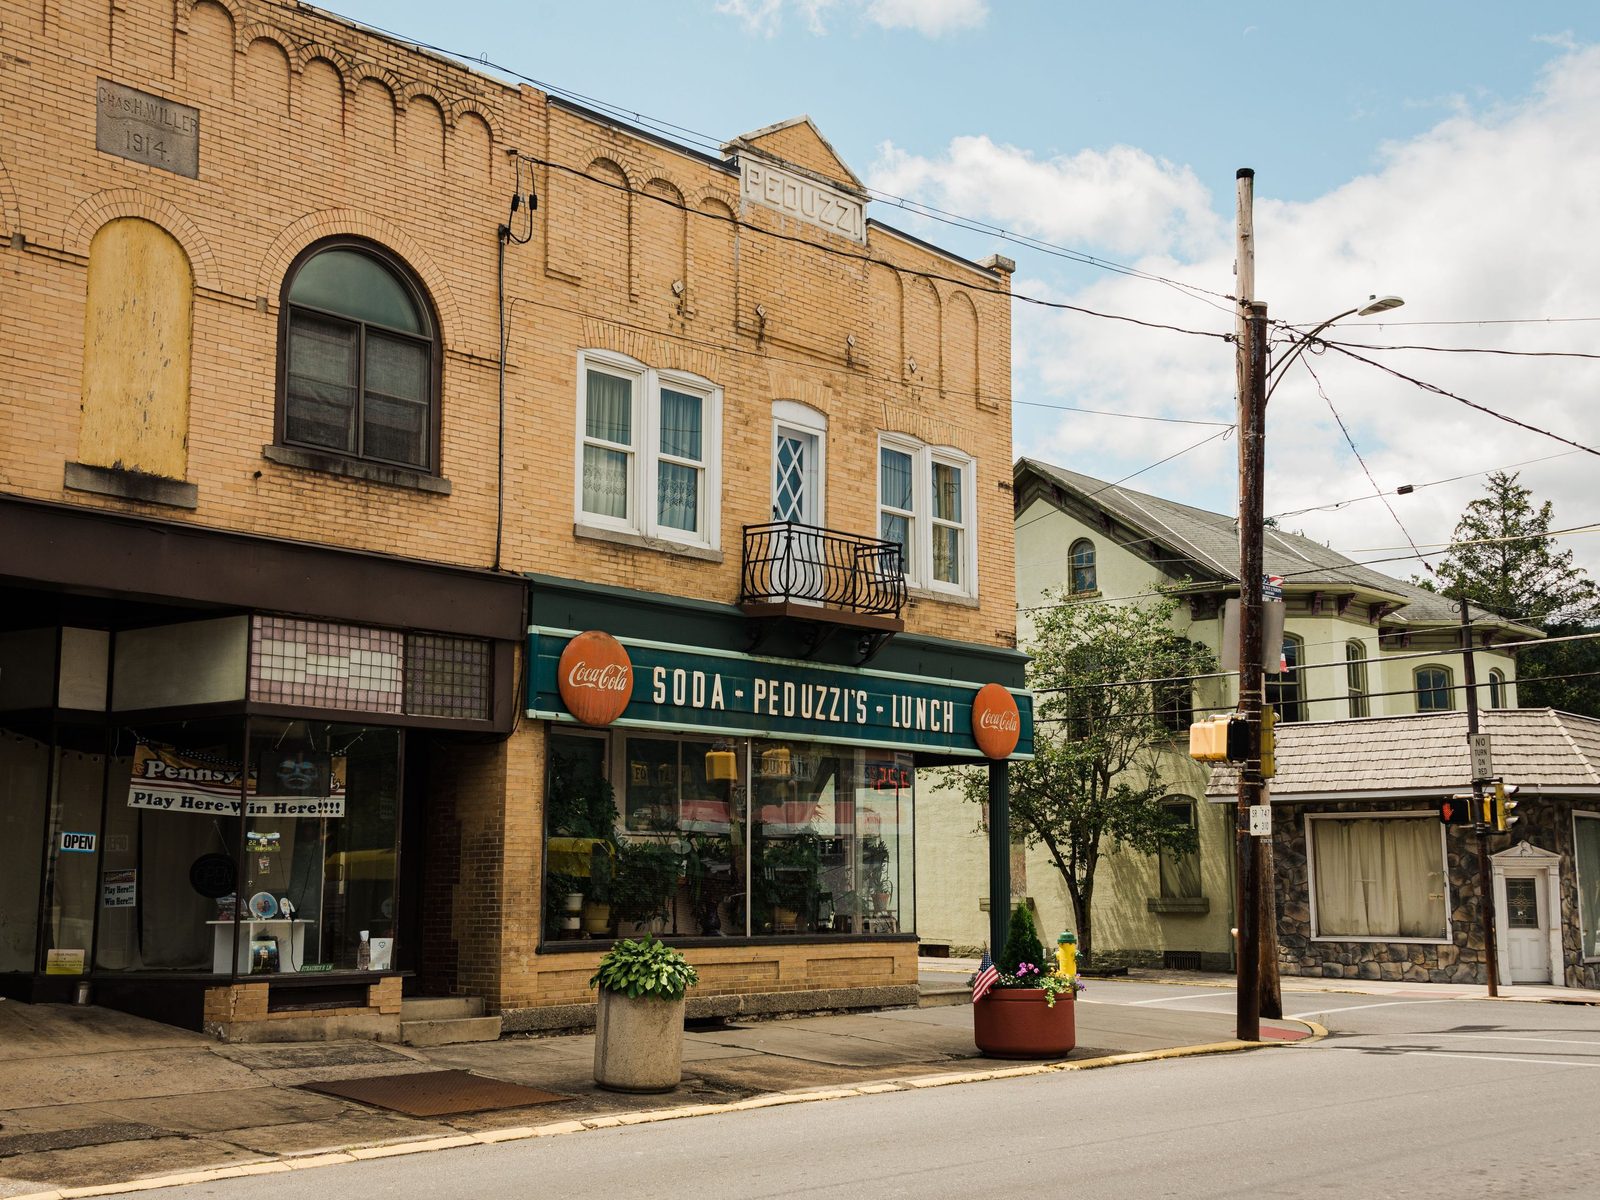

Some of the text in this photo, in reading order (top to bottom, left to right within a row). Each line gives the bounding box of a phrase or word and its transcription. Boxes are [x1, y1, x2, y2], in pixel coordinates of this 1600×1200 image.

[744, 163, 859, 236] PEDUZZI
[653, 666, 725, 710] SODA
[754, 678, 868, 725] PEDUZZI'S
[892, 694, 954, 734] LUNCH
[1475, 738, 1486, 747] NO
[1474, 749, 1488, 757] TURN
[1478, 758, 1486, 766] ON
[1478, 767, 1488, 776] RED
[133, 791, 175, 809] Play
[273, 801, 341, 815] Here!!!!
[63, 834, 94, 850] OPEN
[104, 886, 116, 895] Play
[105, 897, 115, 906] Win
